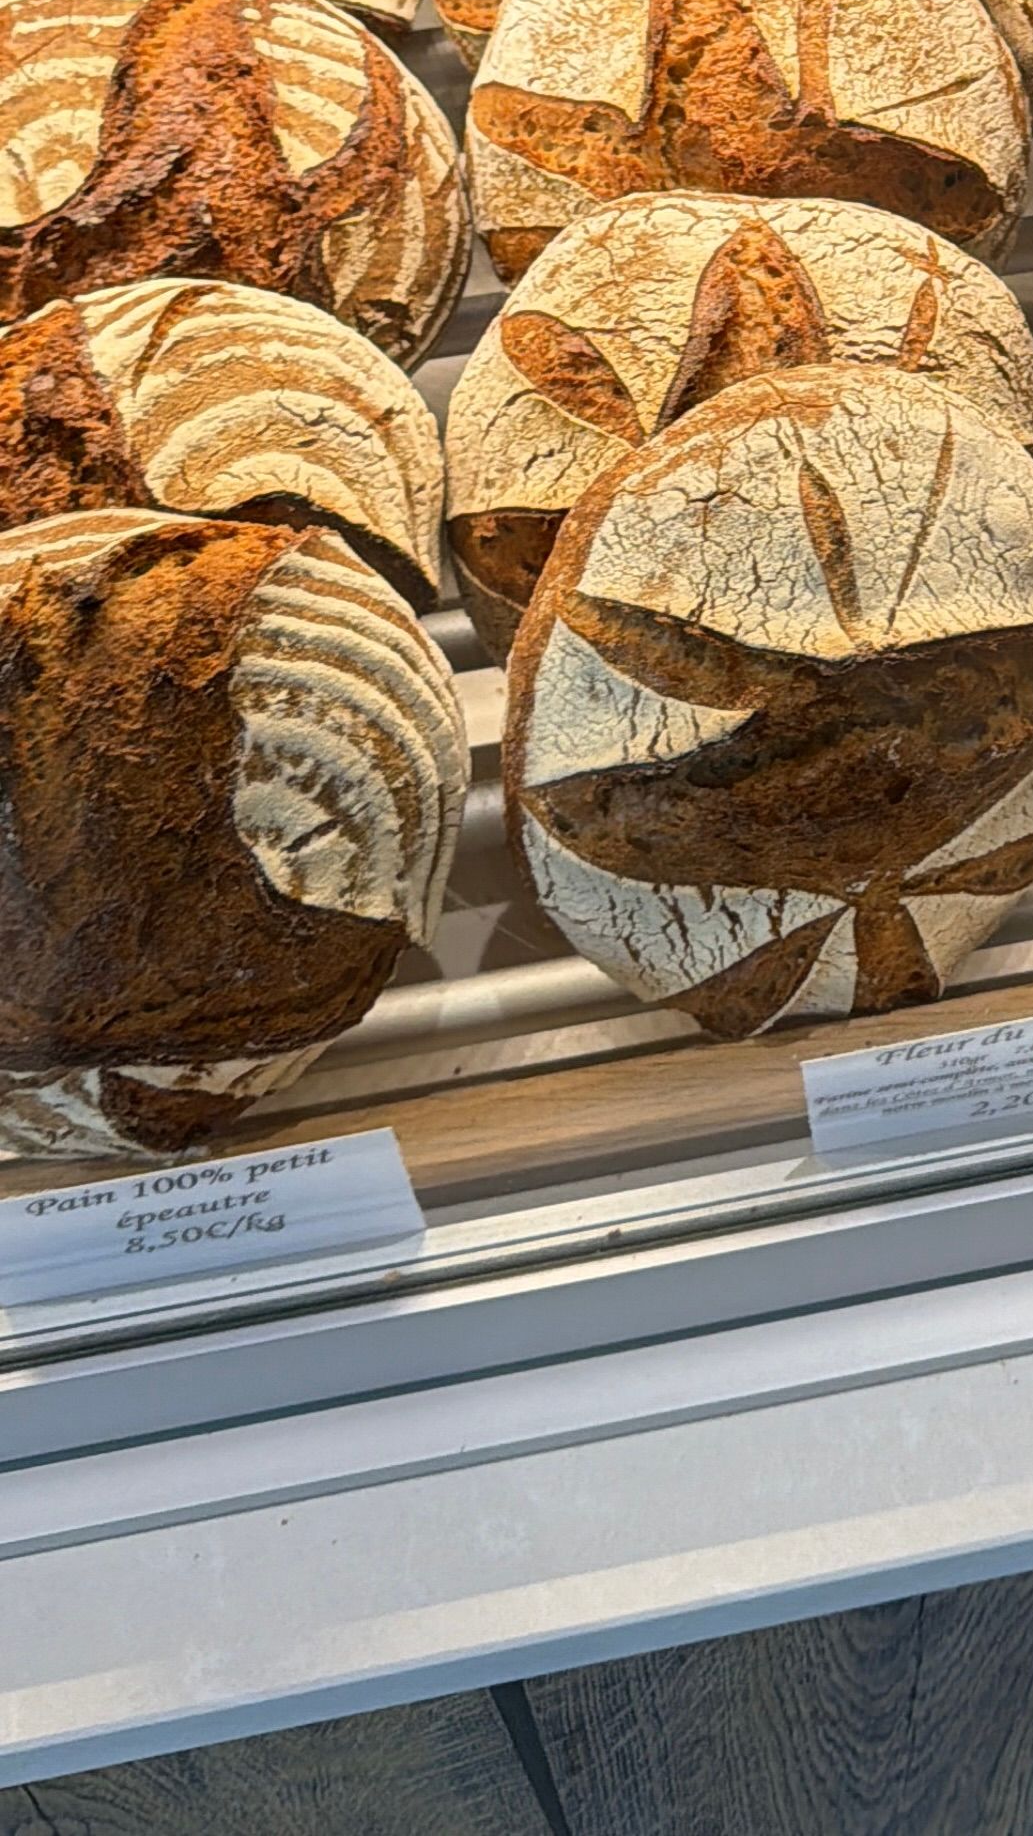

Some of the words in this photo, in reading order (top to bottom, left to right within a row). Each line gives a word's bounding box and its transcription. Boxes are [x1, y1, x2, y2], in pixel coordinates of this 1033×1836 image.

[875, 1035, 976, 1066] Fleur
[981, 1025, 1024, 1046] du
[25, 1190, 117, 1217] Pain
[132, 1166, 233, 1199] 100%
[246, 1147, 333, 1183] petit
[115, 1188, 271, 1232] épeautre
[124, 1212, 287, 1255] 8,50€/kg
